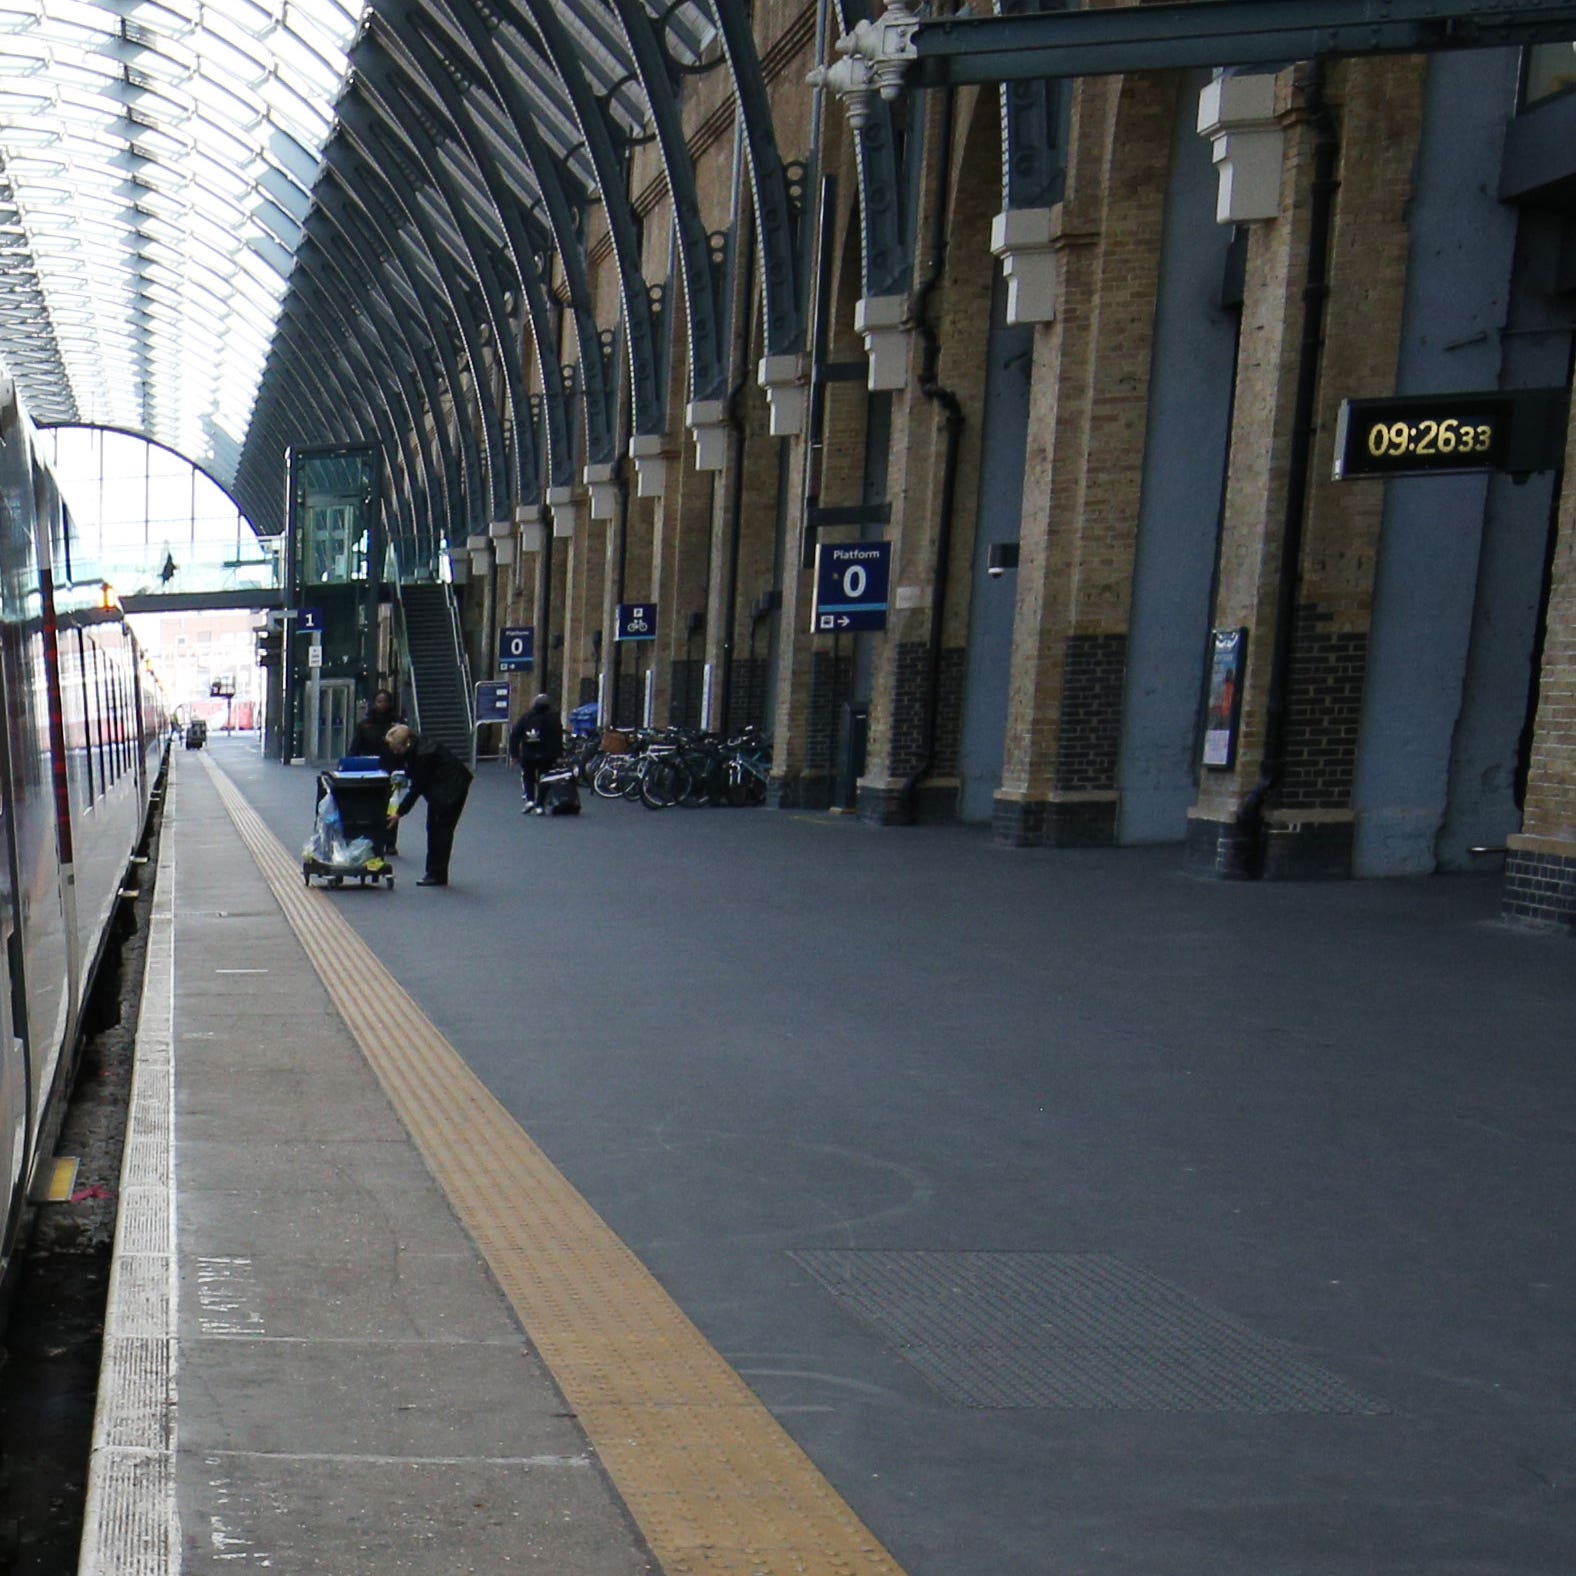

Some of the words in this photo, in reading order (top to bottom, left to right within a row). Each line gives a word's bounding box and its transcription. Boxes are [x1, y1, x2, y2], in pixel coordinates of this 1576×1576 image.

[833, 549, 880, 560] Platform
[843, 565, 867, 597] 0
[305, 613, 315, 627] 1
[511, 638, 523, 655] 0
